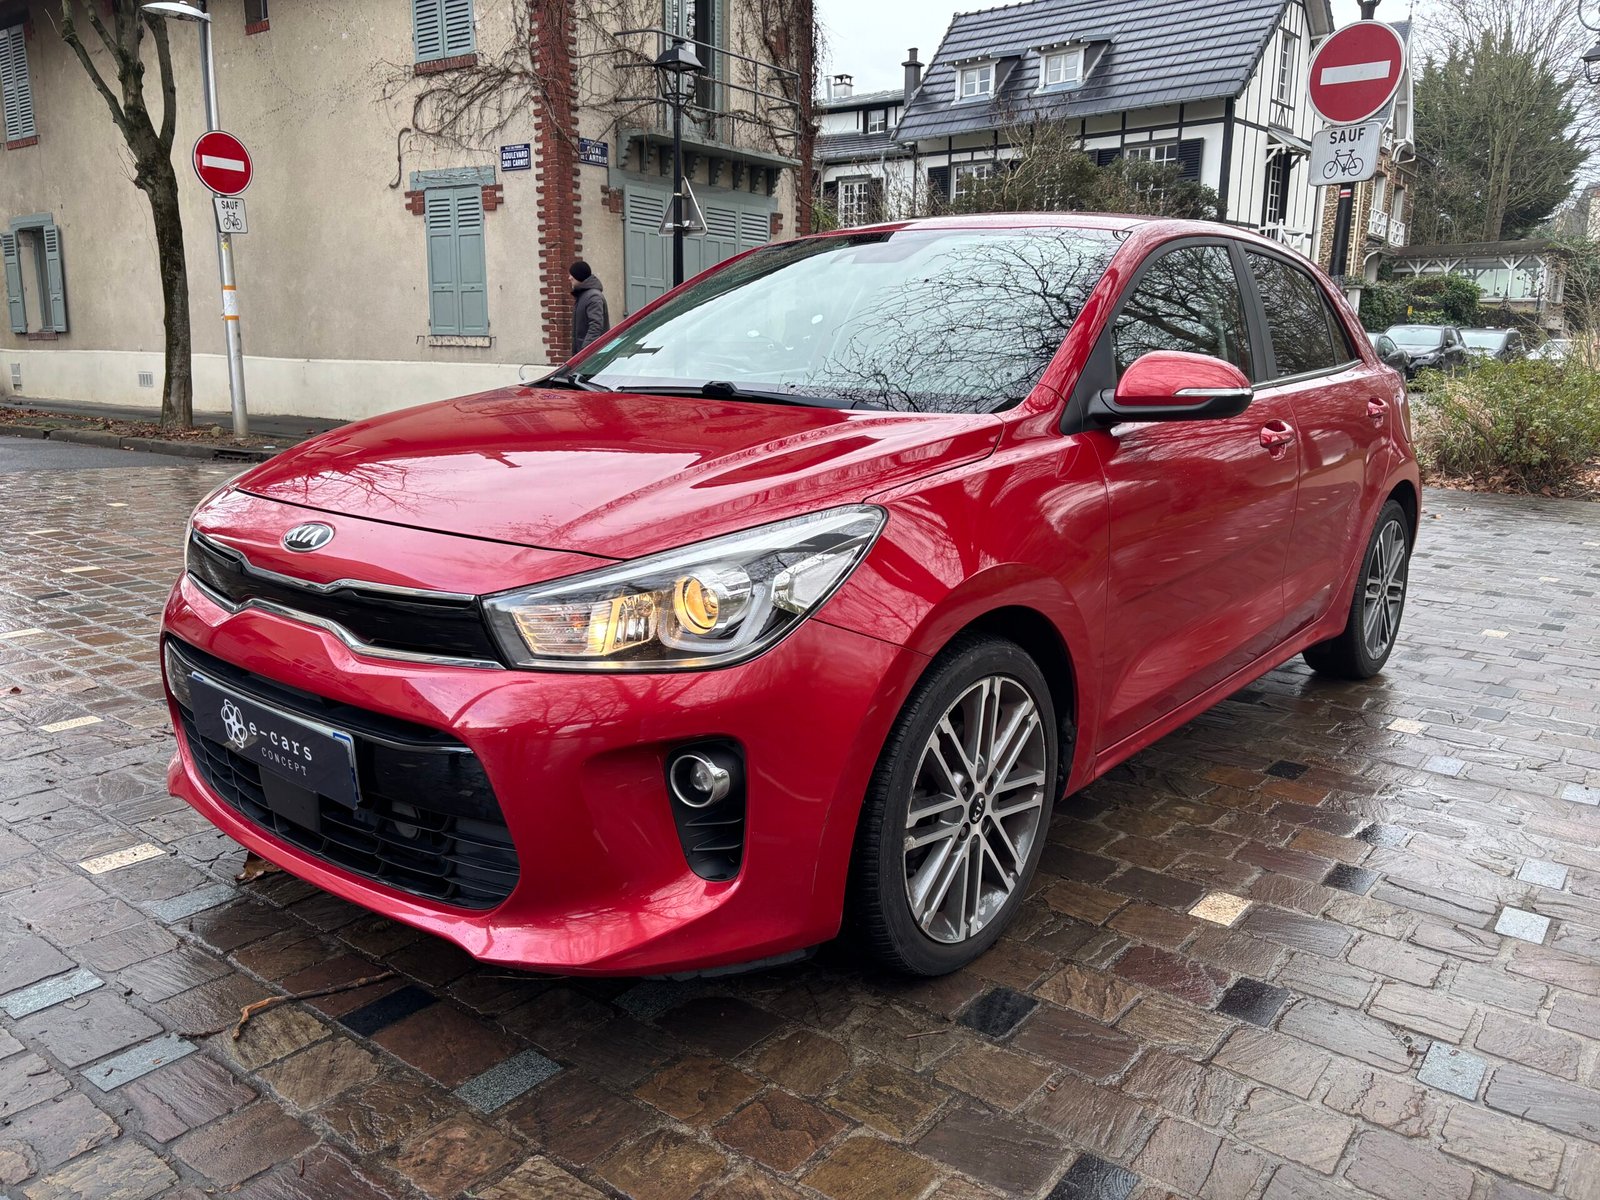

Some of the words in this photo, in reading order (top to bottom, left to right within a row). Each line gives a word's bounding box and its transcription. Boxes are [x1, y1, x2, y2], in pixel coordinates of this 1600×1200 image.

[1329, 127, 1366, 144] SAUF
[502, 150, 528, 160] BOULEVARD
[502, 160, 512, 168] SADI
[512, 158, 528, 167] CARNOT
[221, 200, 238, 210] SAUF
[286, 525, 324, 546] KIA
[249, 721, 313, 761] e-cars
[261, 746, 307, 777] CONCEPT
[972, 797, 984, 822] KIA
